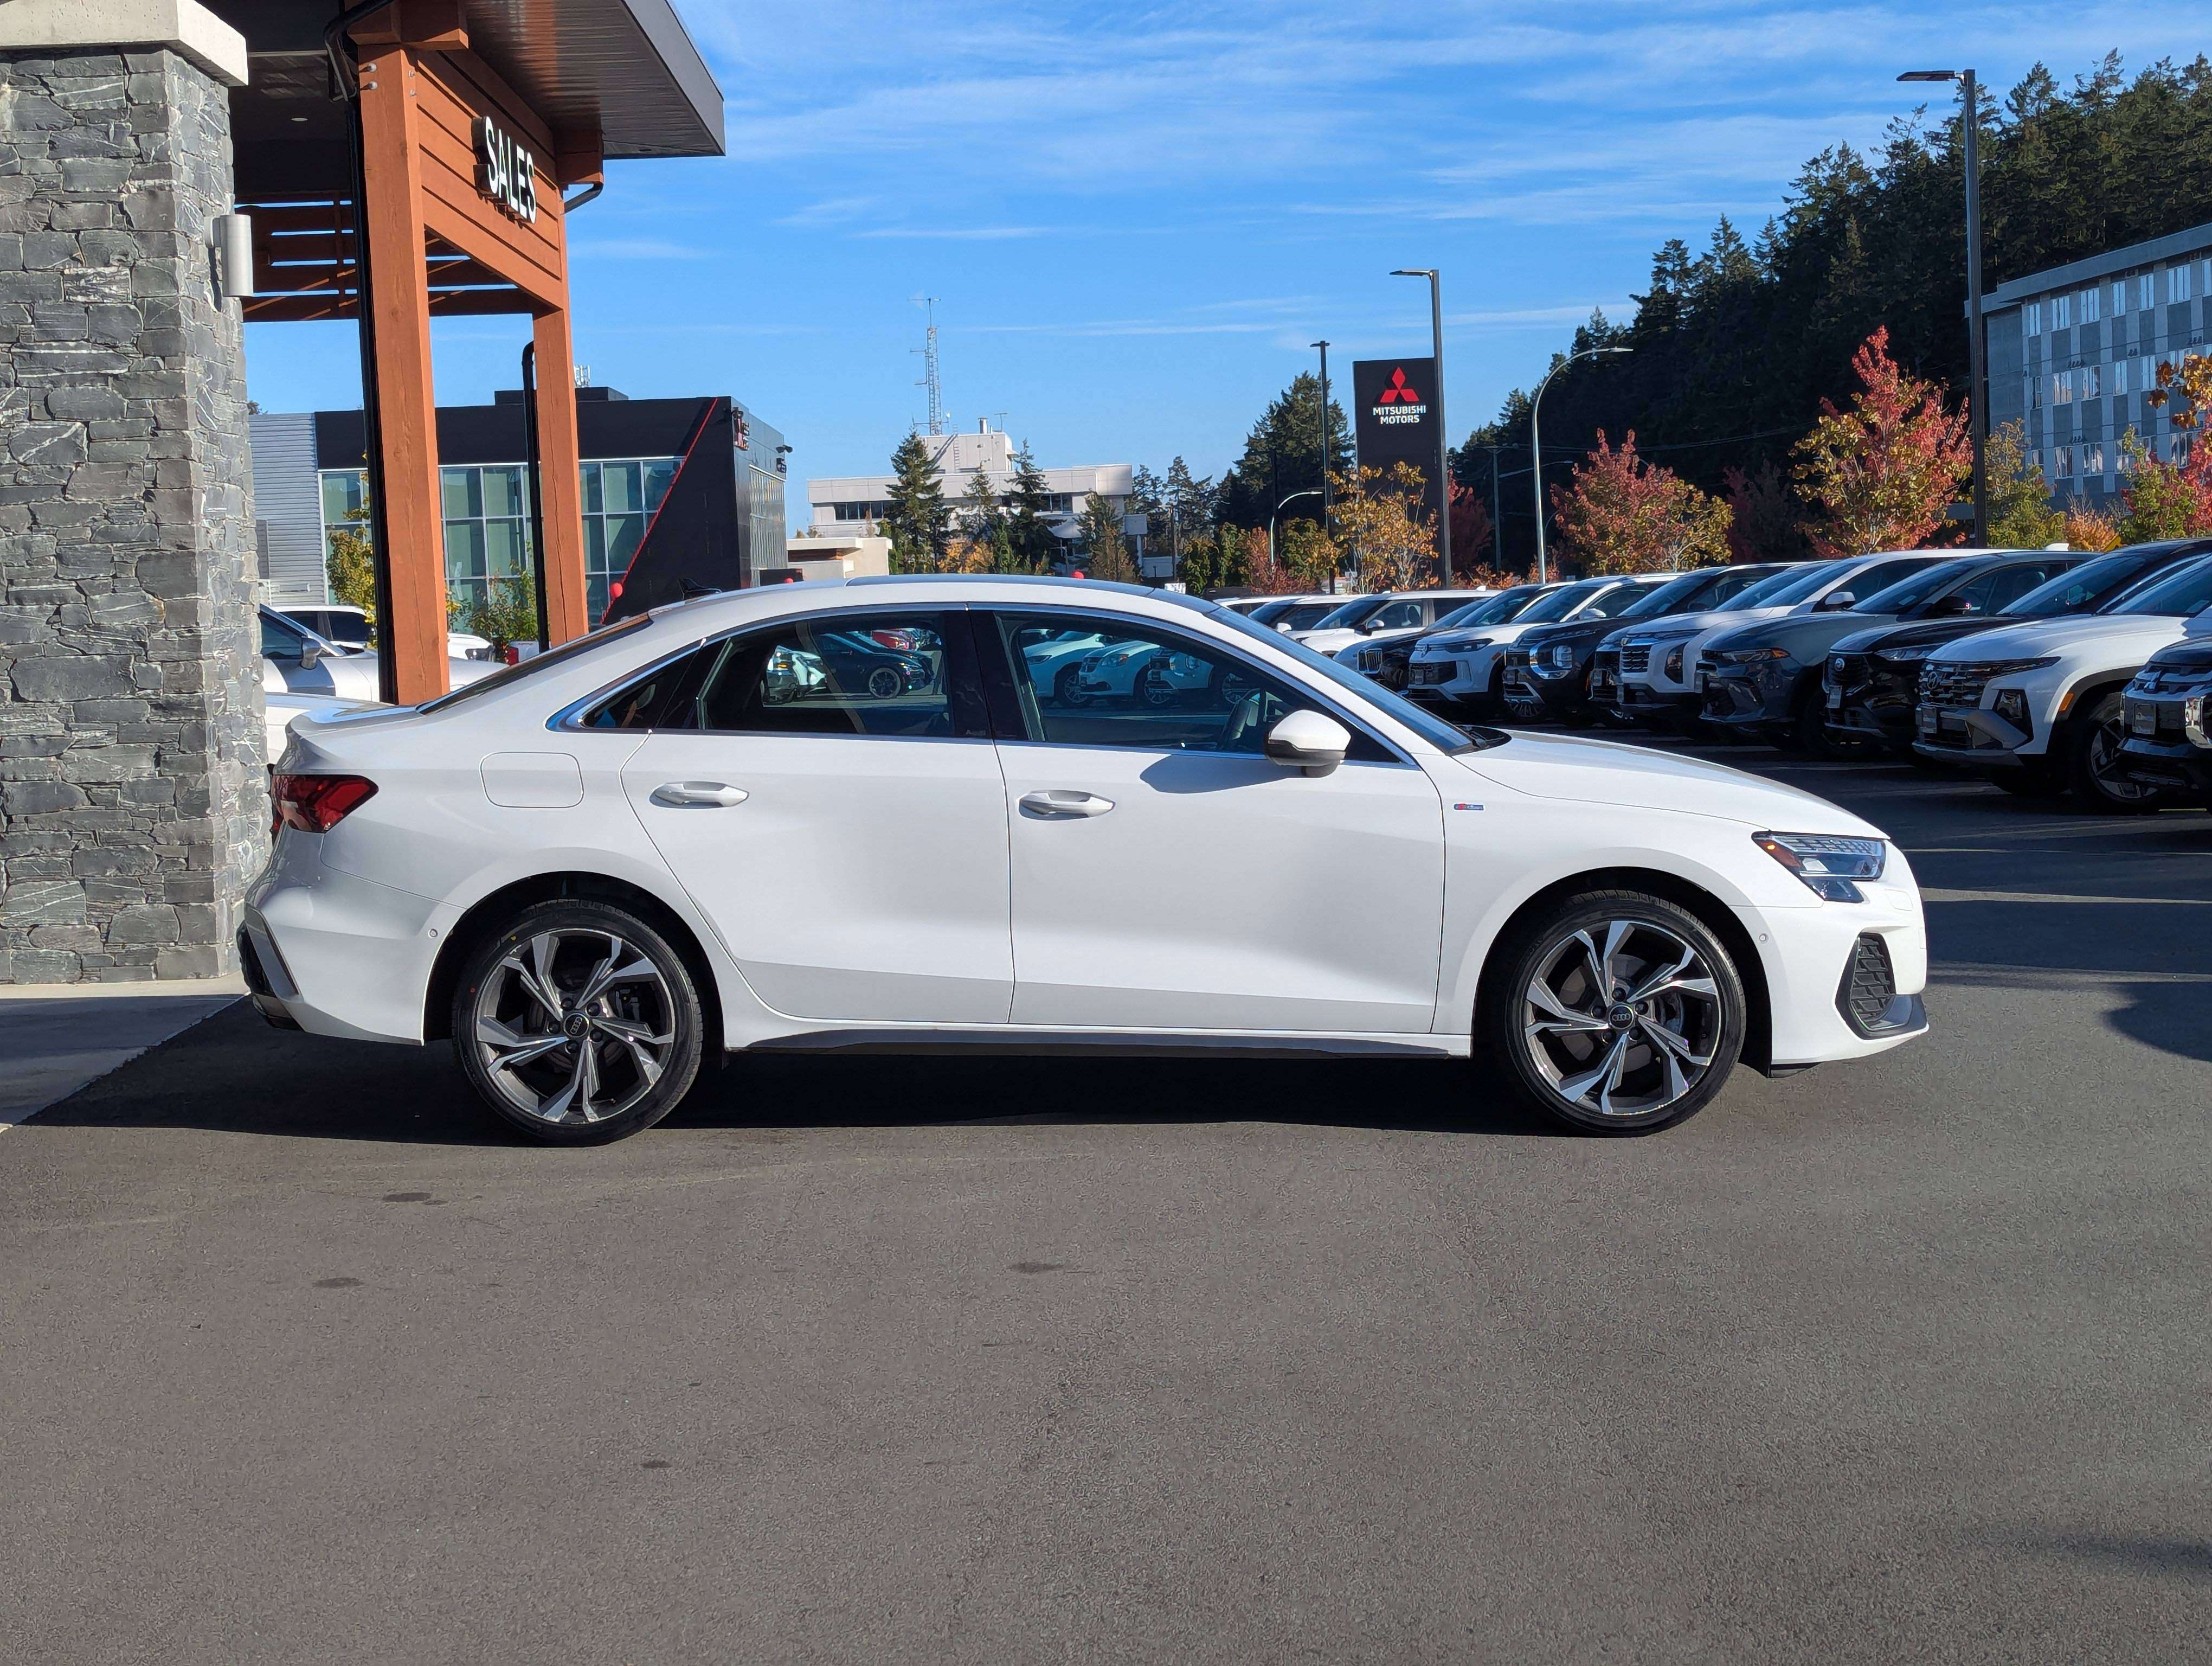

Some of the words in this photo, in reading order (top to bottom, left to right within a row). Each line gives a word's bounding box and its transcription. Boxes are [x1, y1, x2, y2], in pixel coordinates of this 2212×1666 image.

[485, 116, 537, 224] SALES
[1373, 405, 1426, 416] MITSUBISHI
[1380, 415, 1420, 425] MOTORS
